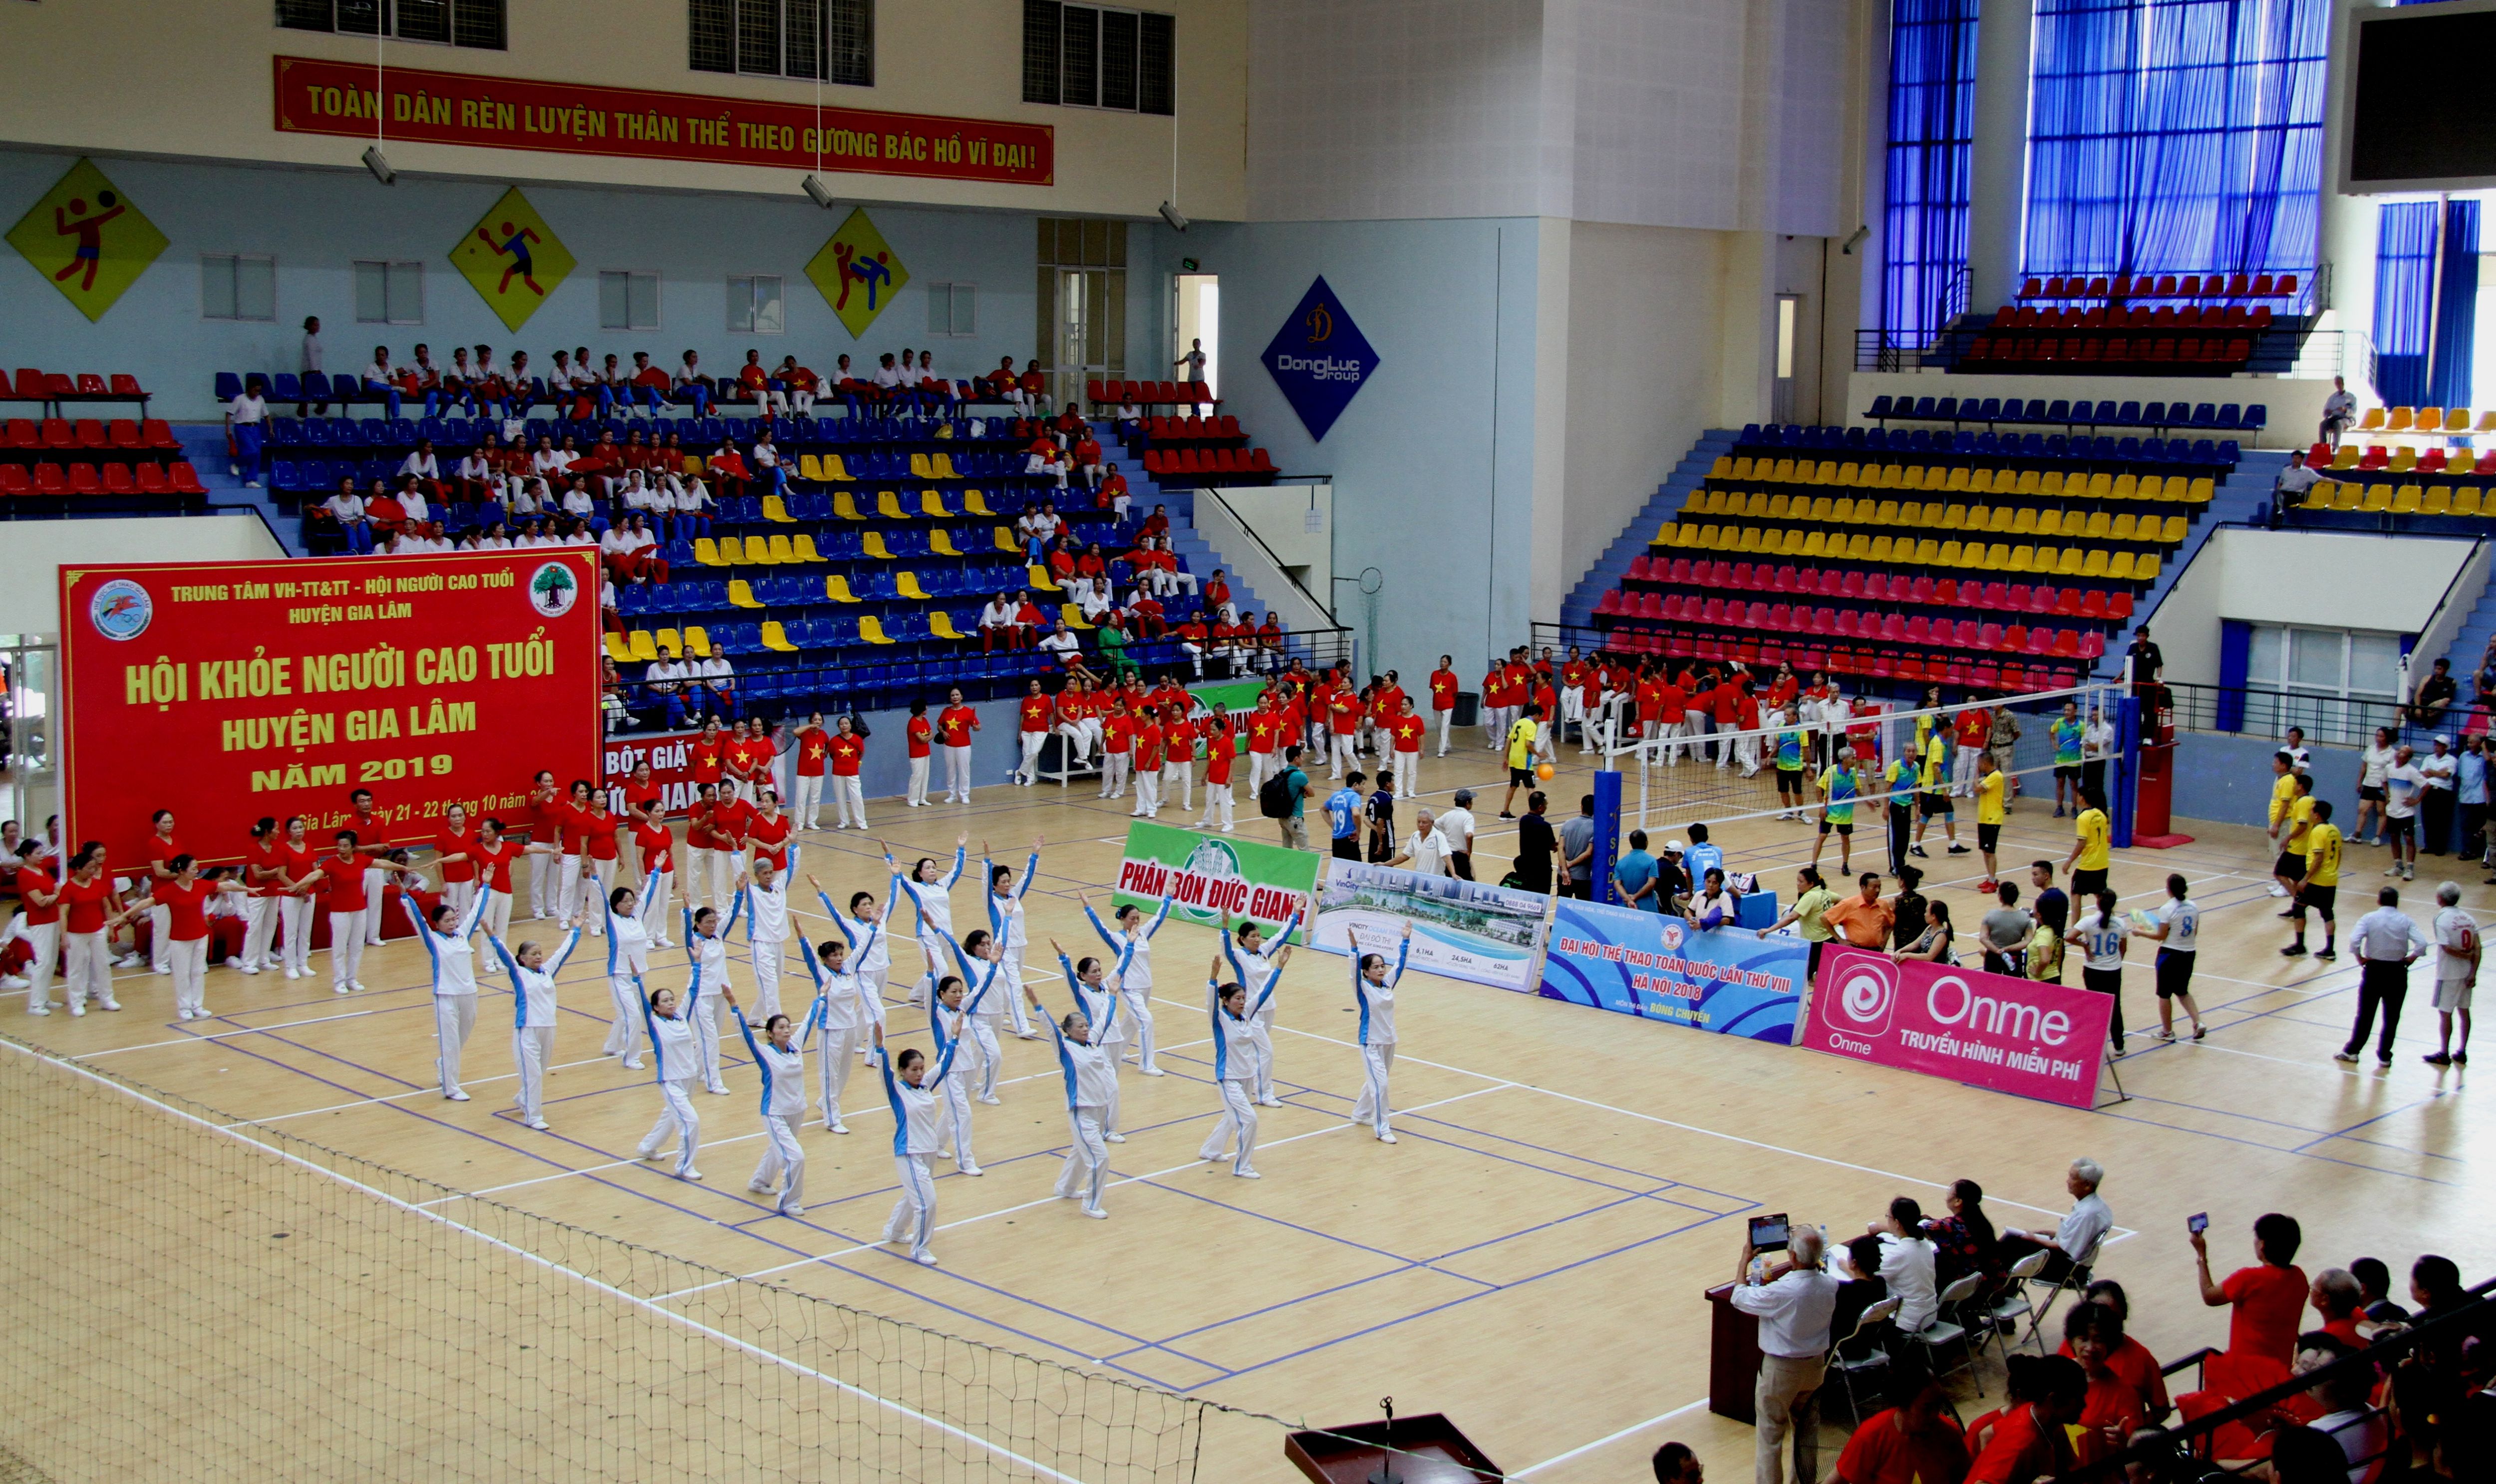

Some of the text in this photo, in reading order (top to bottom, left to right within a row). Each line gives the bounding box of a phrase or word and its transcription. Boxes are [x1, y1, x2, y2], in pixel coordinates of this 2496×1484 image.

[307, 83, 382, 119] TOÀN
[394, 90, 450, 125] DÂN
[461, 96, 515, 130] RÈN
[525, 104, 606, 141] LUYỆN
[615, 107, 678, 142] THÂN
[687, 110, 730, 147] THỂ
[737, 122, 795, 151] THEO
[803, 127, 877, 157] GƯƠNG
[885, 131, 927, 161] BÁC
[935, 132, 962, 164] HỒ
[968, 137, 987, 166] VĨ
[1278, 355, 1360, 379] DongLuc
[171, 585, 228, 602] TRUNG
[234, 582, 269, 600] TÂM
[274, 580, 349, 598] VH-TT&TT
[366, 576, 390, 596] HỘI
[397, 574, 443, 593] NGƯỜI
[448, 574, 477, 590] CAO
[482, 567, 514, 588] TUỔI
[290, 603, 411, 625] HUYỆN GIA LÂM
[126, 626, 553, 712] HỘI KHỎE NGƯỜI CAO TUỔI
[223, 698, 476, 753] HUYỆN GIA LÂM
[1513, 725, 1521, 743] 5
[252, 754, 452, 792] NĂM 2019
[396, 804, 410, 821] 21
[424, 801, 438, 818] 22
[483, 795, 496, 811] 10
[500, 793, 526, 809] năm
[1369, 803, 1374, 822] 3
[1333, 810, 1345, 834] 19
[1120, 862, 1168, 896] PHÂN
[1208, 878, 1248, 913] ĐỨC
[1336, 879, 1359, 892] VinCity
[1741, 877, 1750, 888] 7
[2182, 916, 2193, 937] 8
[1416, 948, 1433, 957] 6,1HA
[2093, 932, 2118, 956] 16
[1451, 955, 1472, 963] 24,5HA
[1560, 938, 1580, 954] ĐẠI
[1581, 939, 1599, 958] HỘI
[1603, 942, 1624, 961] THỂ
[1625, 949, 1651, 966] THAO
[1655, 953, 1684, 973] TOÀN
[1686, 958, 1717, 980] QUỐC
[1746, 969, 1770, 989] THỨ
[1772, 977, 1792, 993] VIII
[1632, 972, 1702, 1000] HÀ NỘI 2018
[1650, 1002, 1673, 1016] BÓNG
[1927, 976, 2069, 1045] Onme
[1829, 1033, 1871, 1055] Onme
[1900, 1029, 2082, 1081] TRUYỀN HÌNH MIỄN PHÍ
